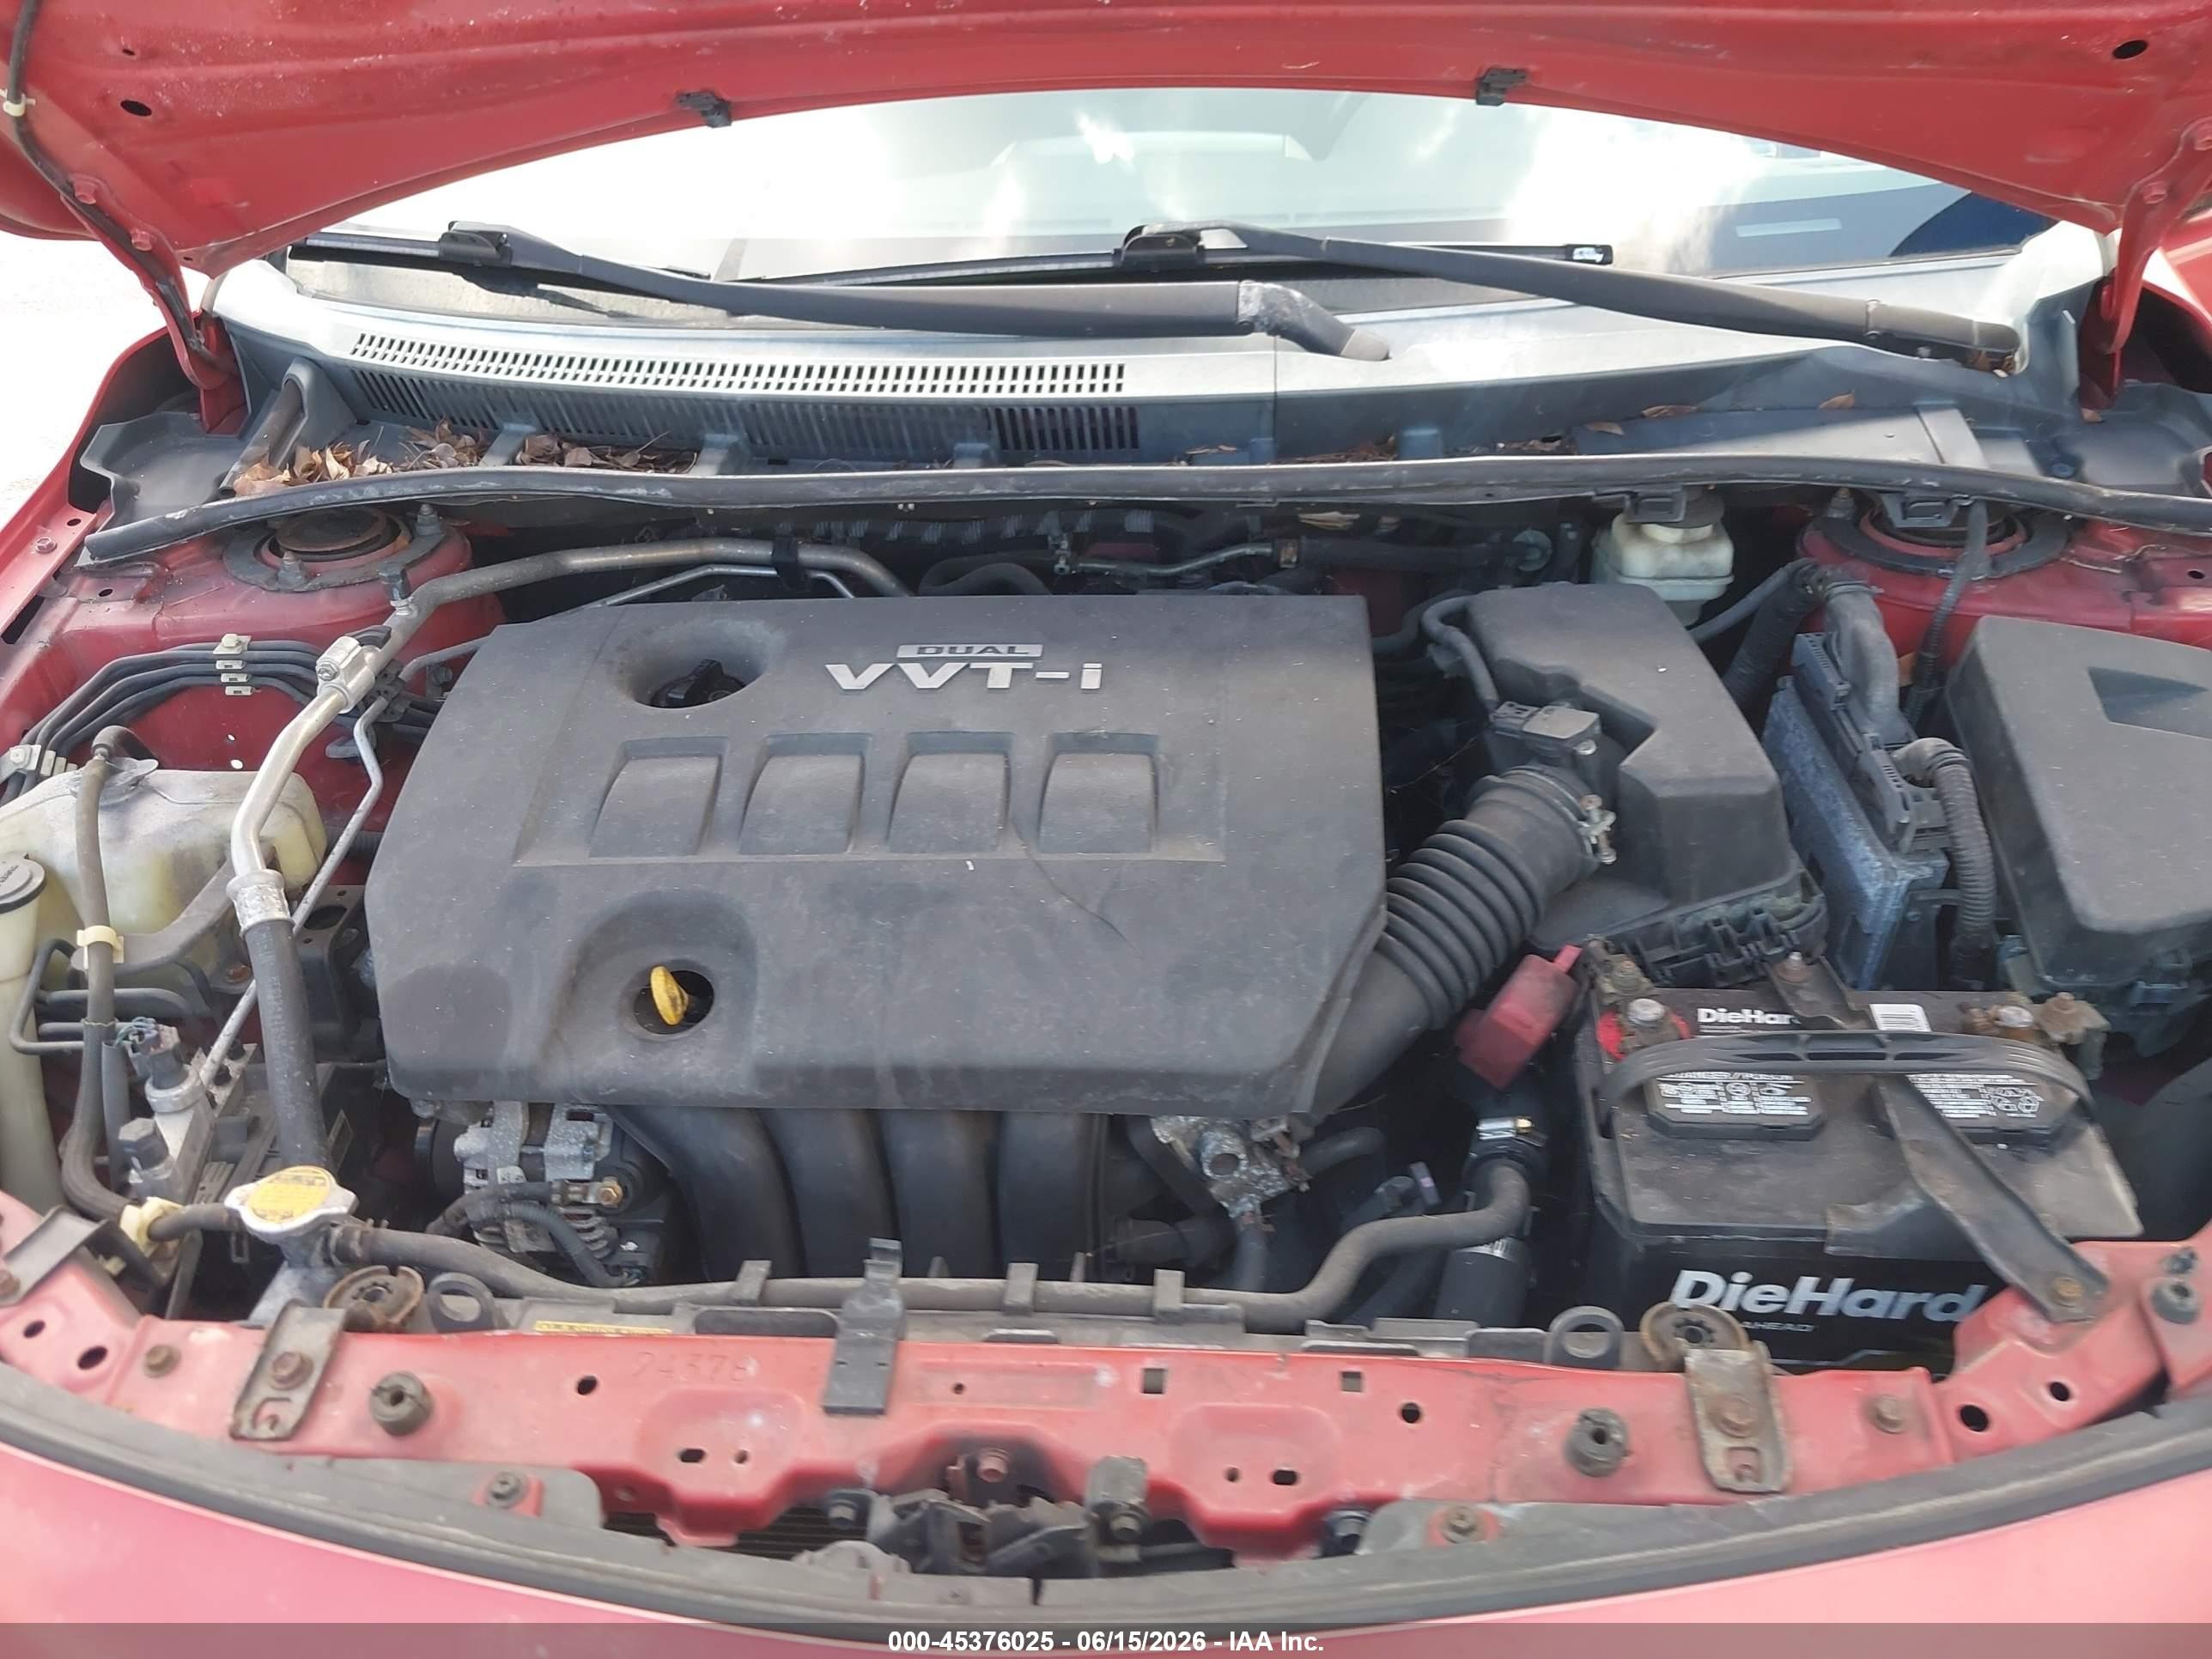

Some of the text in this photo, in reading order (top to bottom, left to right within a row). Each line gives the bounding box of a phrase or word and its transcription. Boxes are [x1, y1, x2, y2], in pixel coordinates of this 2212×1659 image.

[916, 645, 1030, 655] DUAL
[825, 662, 1103, 690] VVT-i
[1670, 1269, 1989, 1323] DieHard
